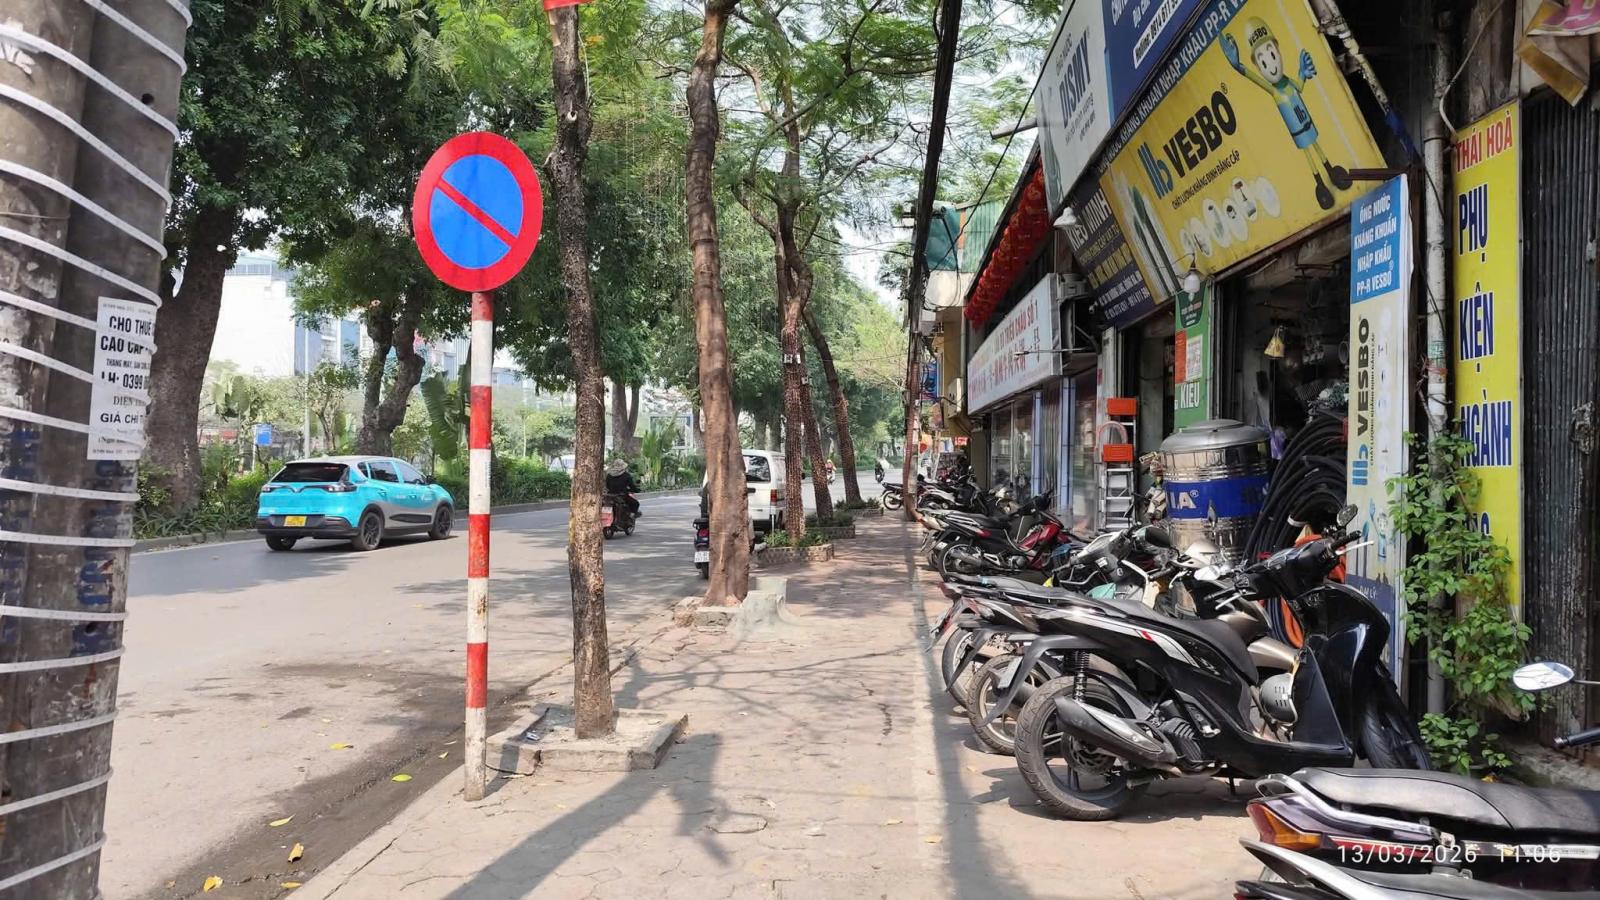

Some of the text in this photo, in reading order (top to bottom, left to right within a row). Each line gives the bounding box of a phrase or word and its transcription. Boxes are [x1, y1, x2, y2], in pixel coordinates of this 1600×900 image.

[1204, 0, 1231, 38] PP-R
[1059, 30, 1091, 129] DISMY
[1163, 90, 1237, 178] VESBO
[1456, 127, 1482, 172] THÁI
[1081, 188, 1112, 234] MINH
[1459, 184, 1488, 262] PHỤ
[1356, 271, 1392, 296] PP-R VESBO
[100, 335, 125, 353] CAO
[109, 315, 132, 333] CHO
[1459, 281, 1494, 373] KIỆN
[1358, 318, 1369, 436] VESBO
[1460, 389, 1513, 468] NGÀNH
